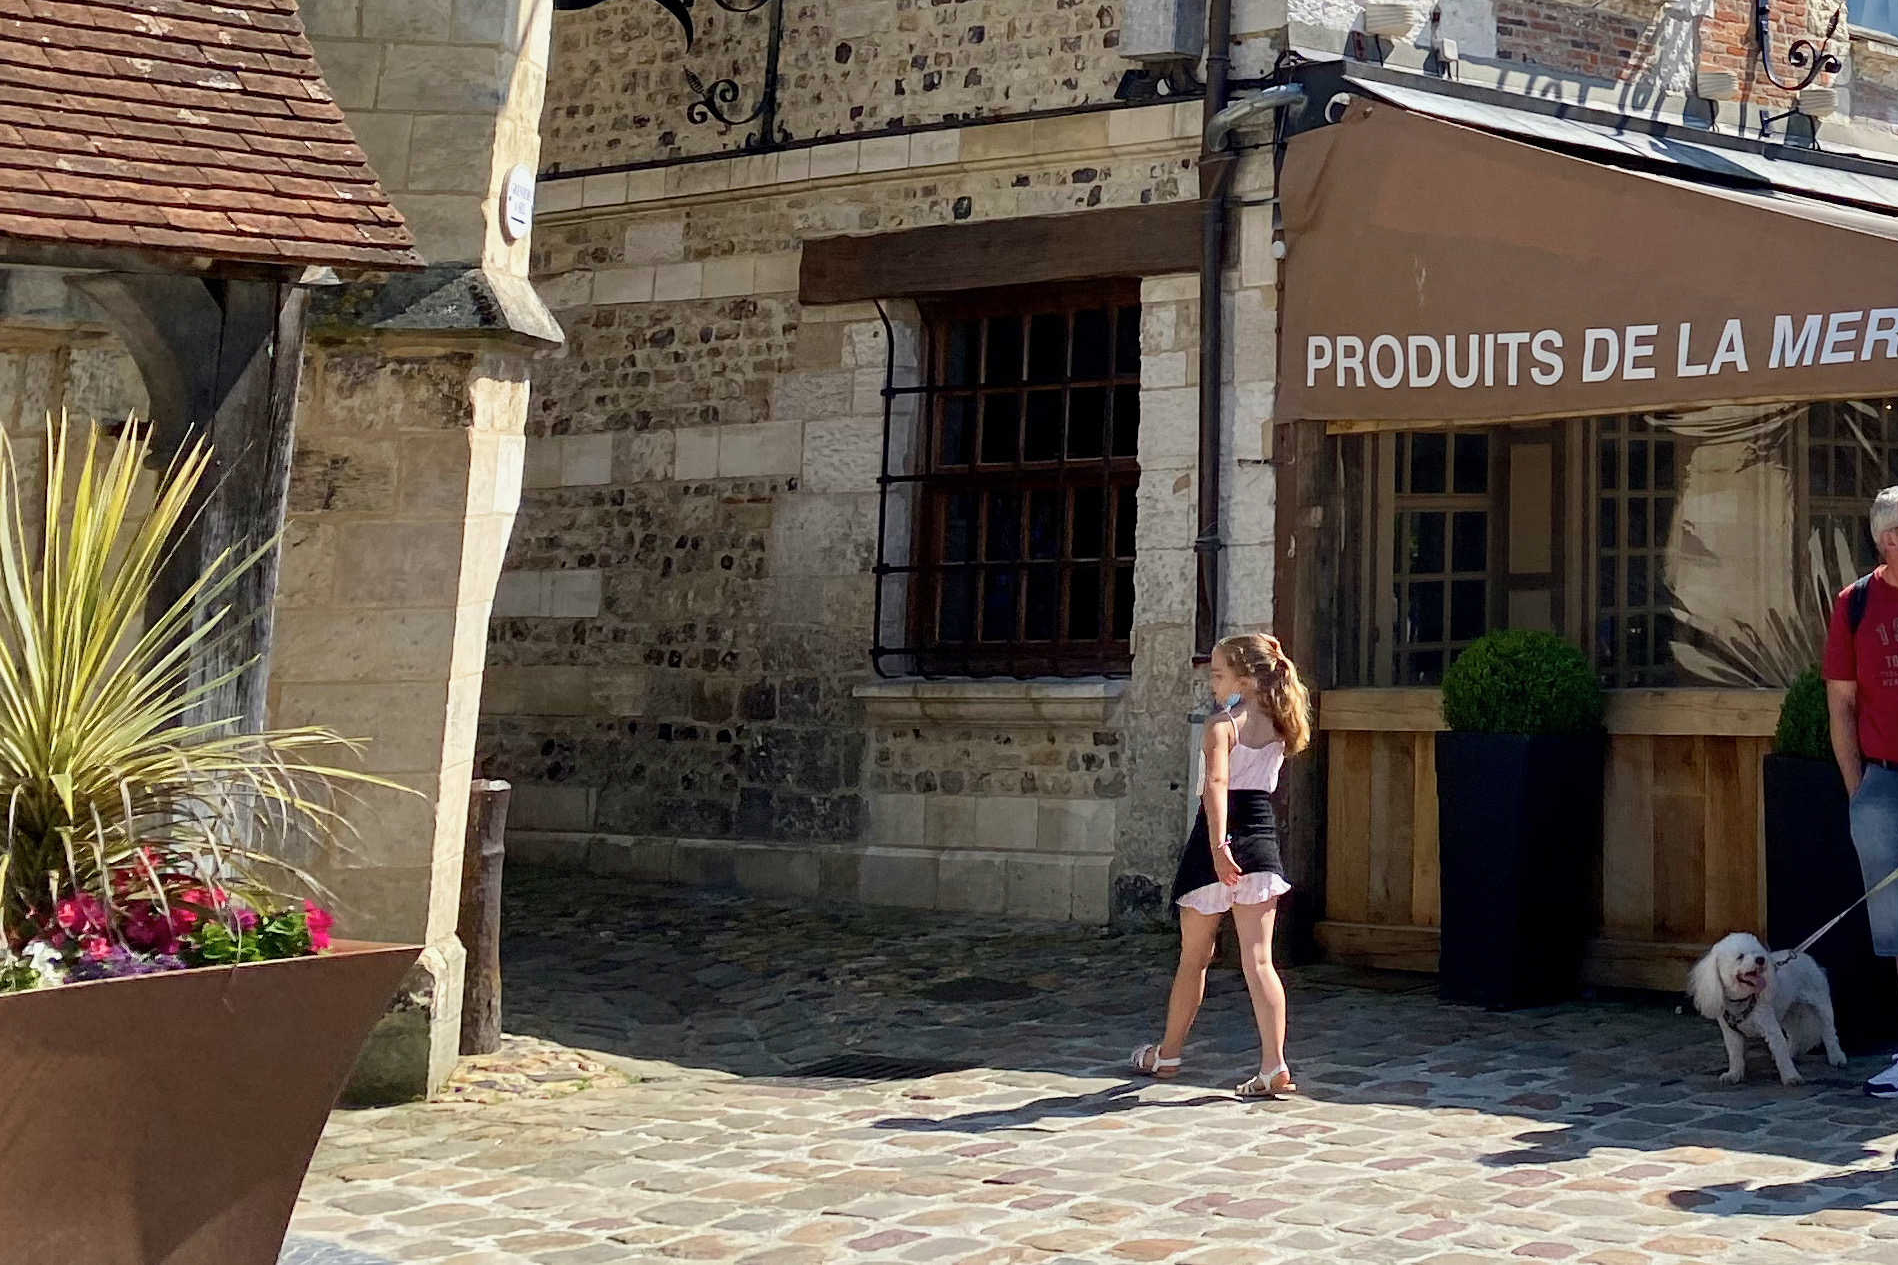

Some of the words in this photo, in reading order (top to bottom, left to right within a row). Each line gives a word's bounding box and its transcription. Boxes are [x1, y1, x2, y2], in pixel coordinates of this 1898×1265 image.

[1306, 329, 1564, 389] PRODUITS
[1582, 324, 1659, 383] DE
[1677, 318, 1749, 378] LA
